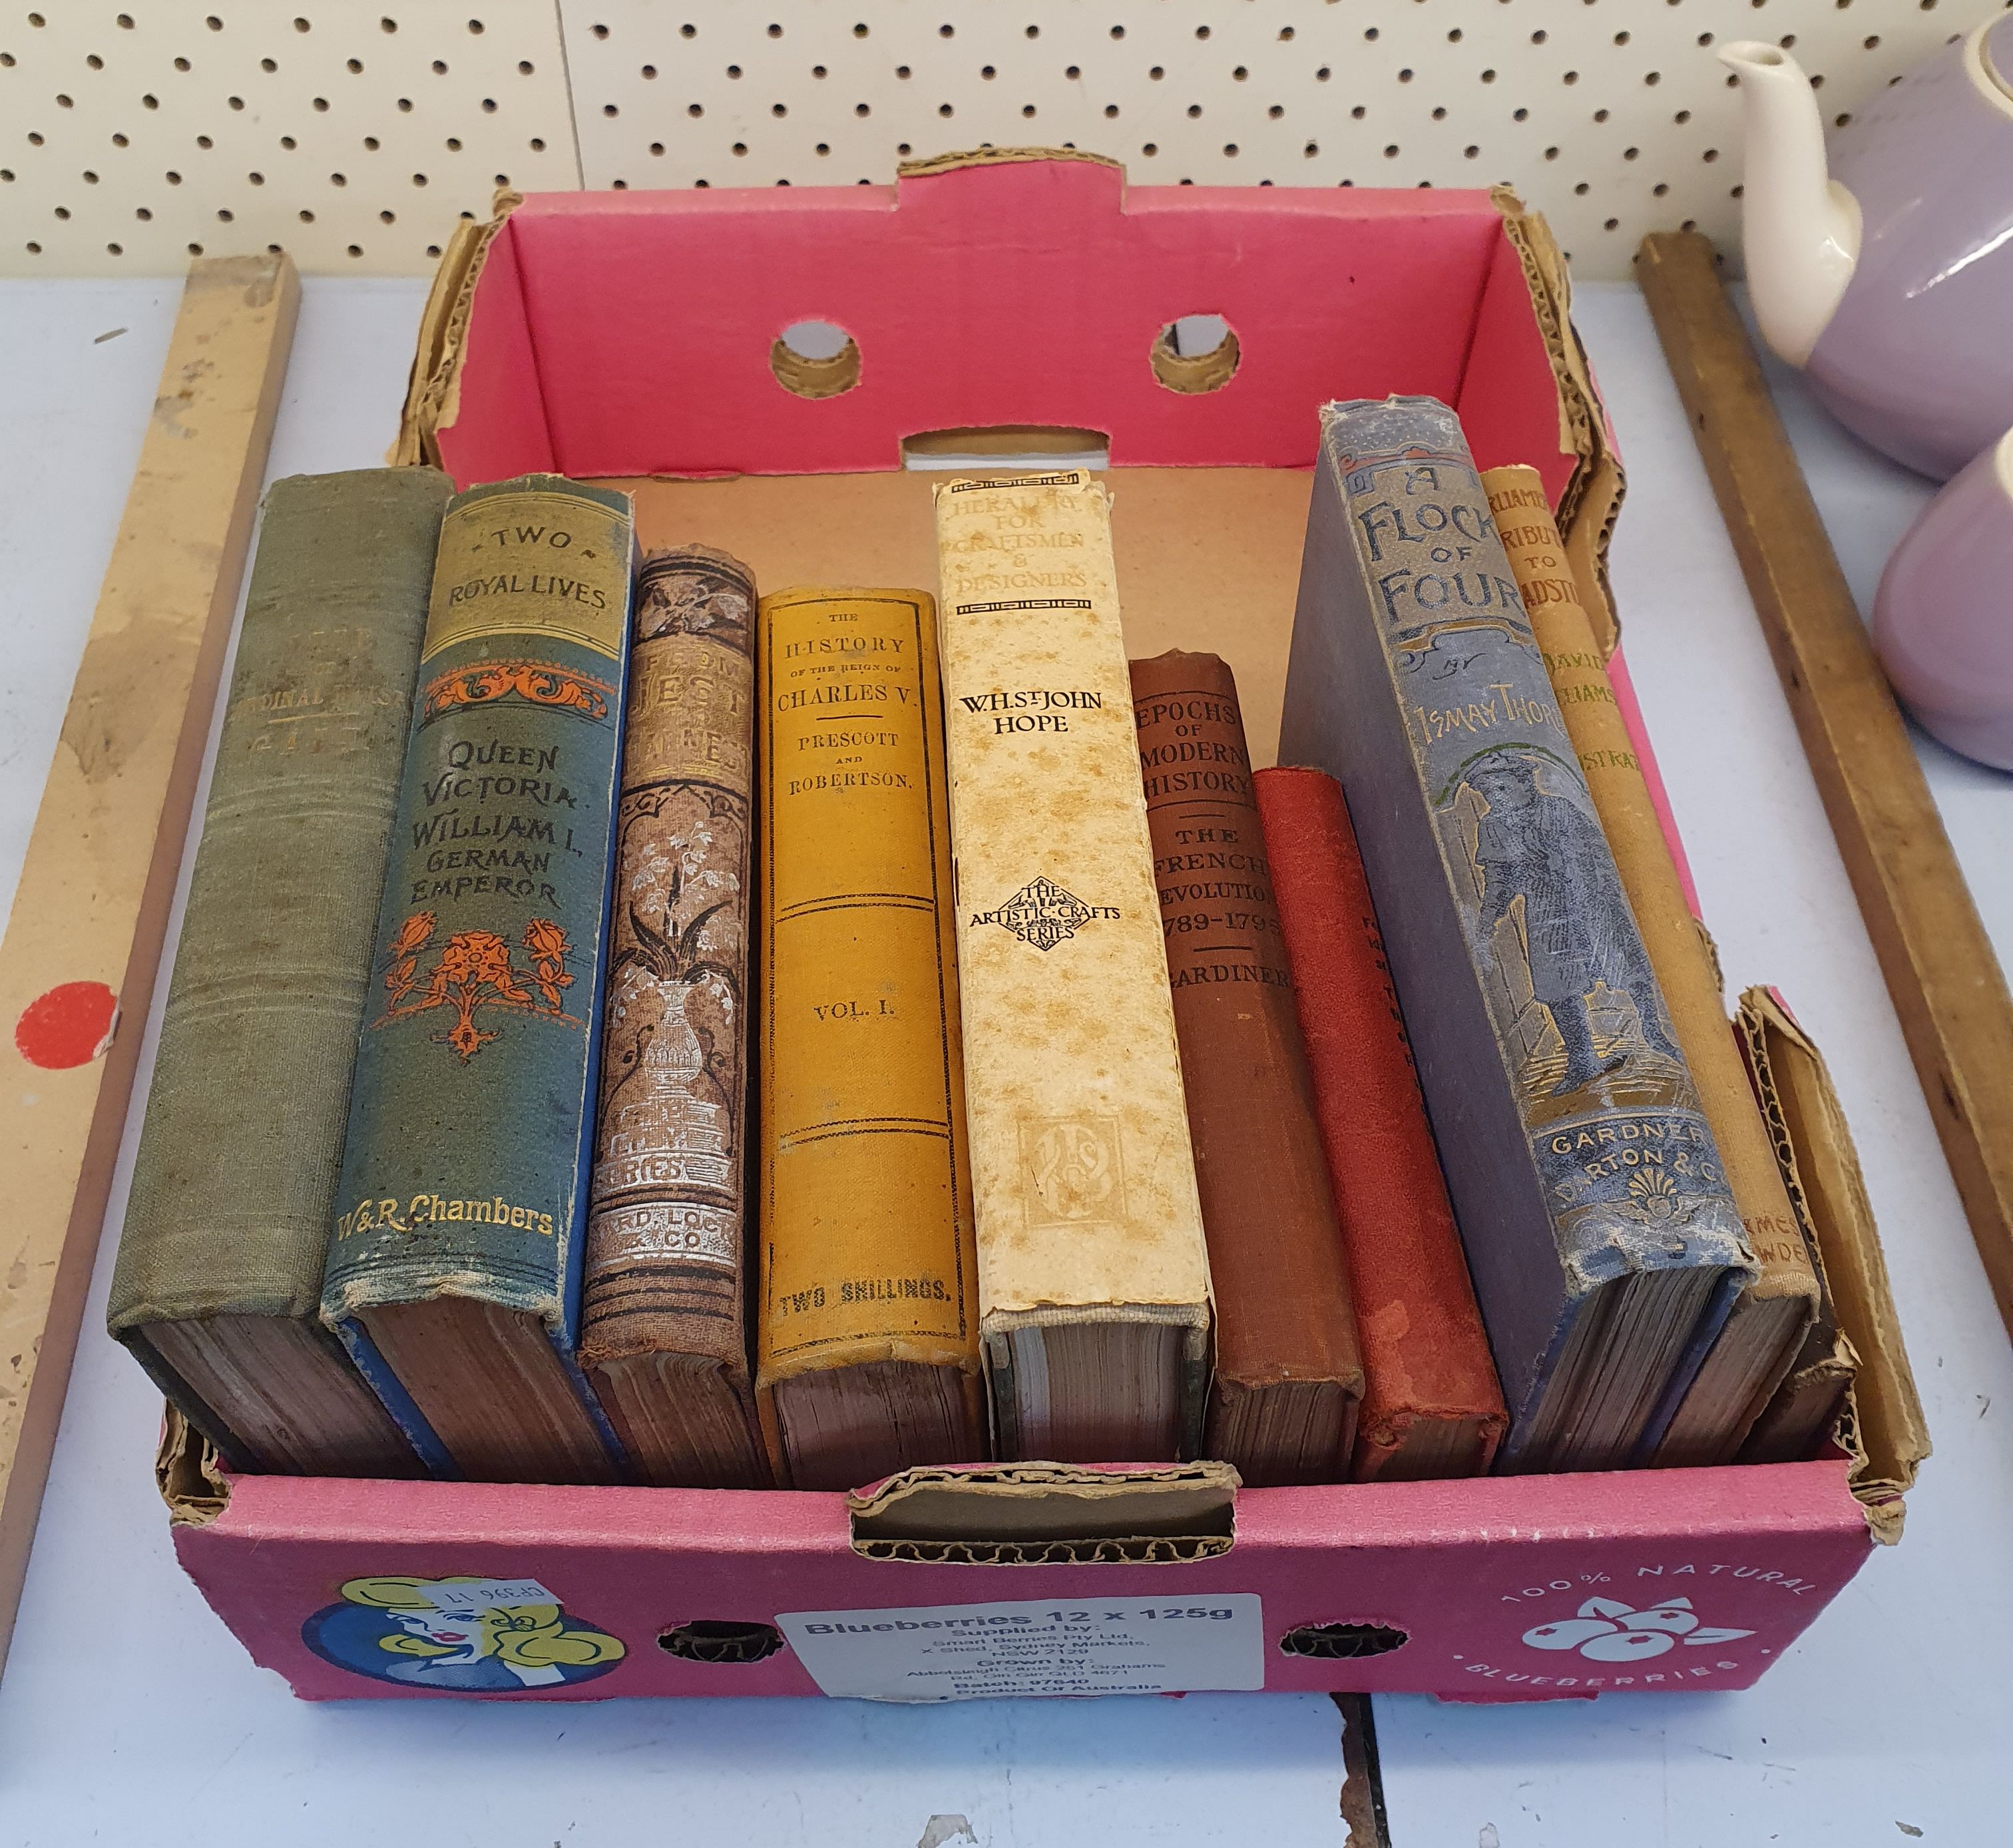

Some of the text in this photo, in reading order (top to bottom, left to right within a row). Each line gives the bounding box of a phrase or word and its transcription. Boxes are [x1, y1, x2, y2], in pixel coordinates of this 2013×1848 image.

[1405, 467, 1440, 495] A
[995, 515, 1045, 530] FOR
[1358, 501, 1503, 562] FLOCK
[491, 526, 572, 549] TWO
[1431, 547, 1472, 563] OF
[1524, 555, 1556, 569] TO
[448, 574, 606, 609] ROYAL LIVES
[1377, 567, 1528, 624] FOUR
[829, 613, 858, 622] THE
[785, 637, 905, 659] HISTORY
[790, 664, 901, 678] OF THE REIGN OF
[778, 684, 917, 712] CHARLES V.
[993, 715, 1068, 735] HOPE
[1135, 700, 1237, 730] EPOCHS
[798, 732, 899, 752] PRESCOTT
[1175, 724, 1202, 737] OF
[448, 738, 560, 774] QUEEN
[835, 755, 863, 765] AND
[1140, 741, 1245, 771] MODERN
[788, 772, 915, 796] ROBERTSON.
[1143, 770, 1253, 799] HISTORY
[412, 808, 557, 851] WILLIAM
[1174, 828, 1239, 845] THE
[427, 849, 551, 876] GERMAN
[1153, 852, 1268, 877] FRENCH
[409, 874, 562, 910] EMPEROR
[1021, 885, 1060, 899] THE
[969, 905, 1121, 927] ARTISTIC CRAFTS
[1016, 926, 1075, 941] SERIES
[1169, 964, 1290, 989] ARDINER
[813, 1000, 870, 1021] VOL.
[1552, 1123, 1709, 1154] GARDNER
[409, 1194, 553, 1236] Chambers
[779, 1277, 951, 1317] TWO SHILLINGS.
[1501, 1564, 1817, 1603] 100% NATURAL
[803, 1607, 1233, 1635] Blueberries 12 x 125g
[951, 1625, 1056, 1637] Supplied
[1464, 1660, 1739, 1687] BLUEBERRIES
